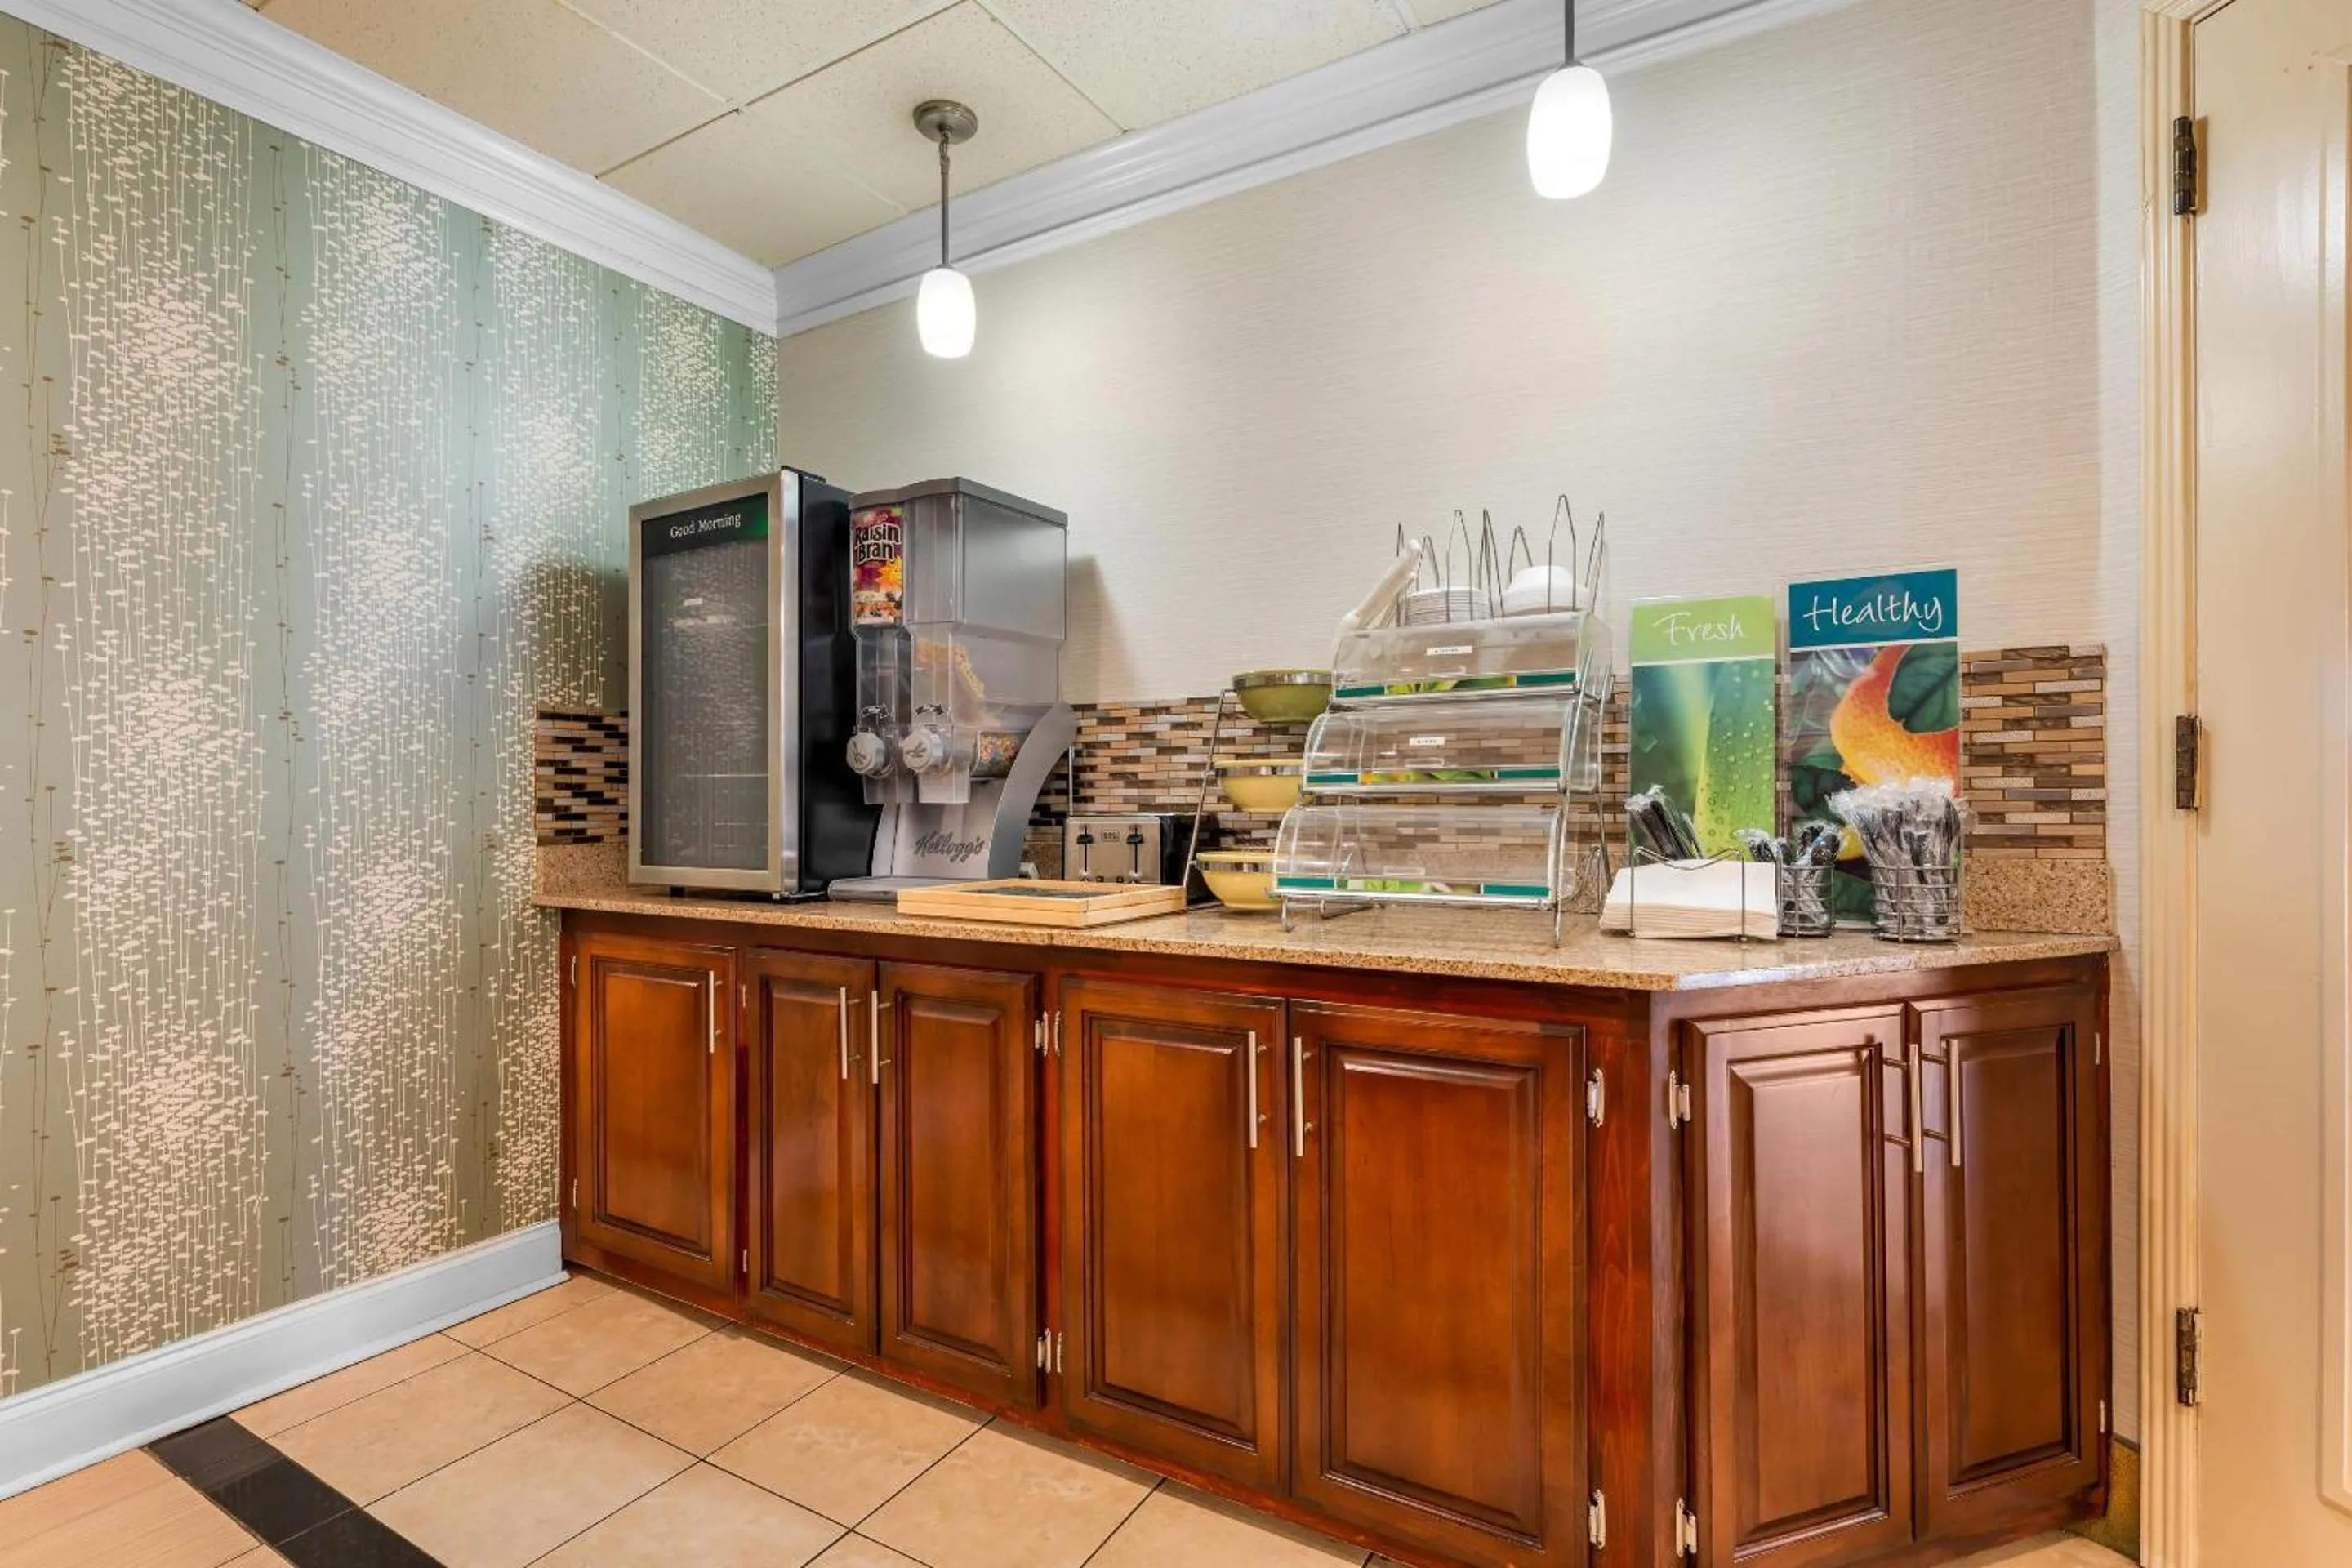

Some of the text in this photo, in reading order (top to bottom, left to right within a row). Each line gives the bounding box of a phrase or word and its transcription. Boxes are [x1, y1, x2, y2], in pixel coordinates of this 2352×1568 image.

[670, 513, 741, 538] Good Morning
[855, 522, 902, 545] Raisin
[856, 540, 896, 564] Bran
[1802, 590, 1943, 633] Healthy
[1651, 611, 1747, 646] Fresh
[913, 831, 985, 864] Kellogg's
